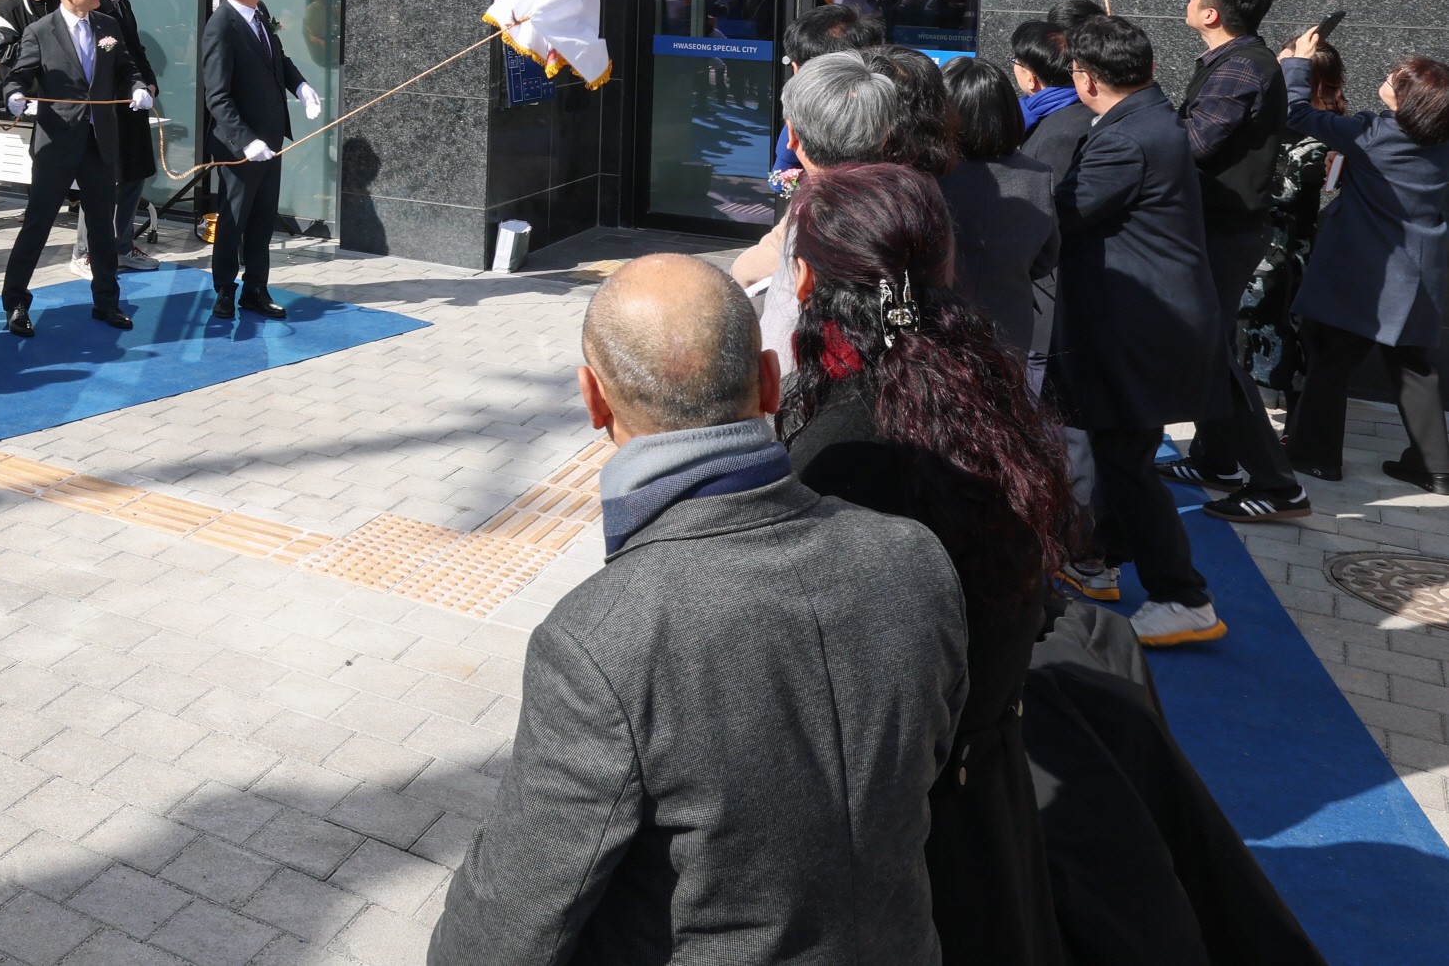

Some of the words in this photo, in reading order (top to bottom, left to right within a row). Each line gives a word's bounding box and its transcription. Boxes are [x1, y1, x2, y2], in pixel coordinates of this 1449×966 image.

[673, 42, 711, 51] HWASEONG
[712, 44, 741, 53] SPECIAL
[742, 46, 758, 54] CITY
